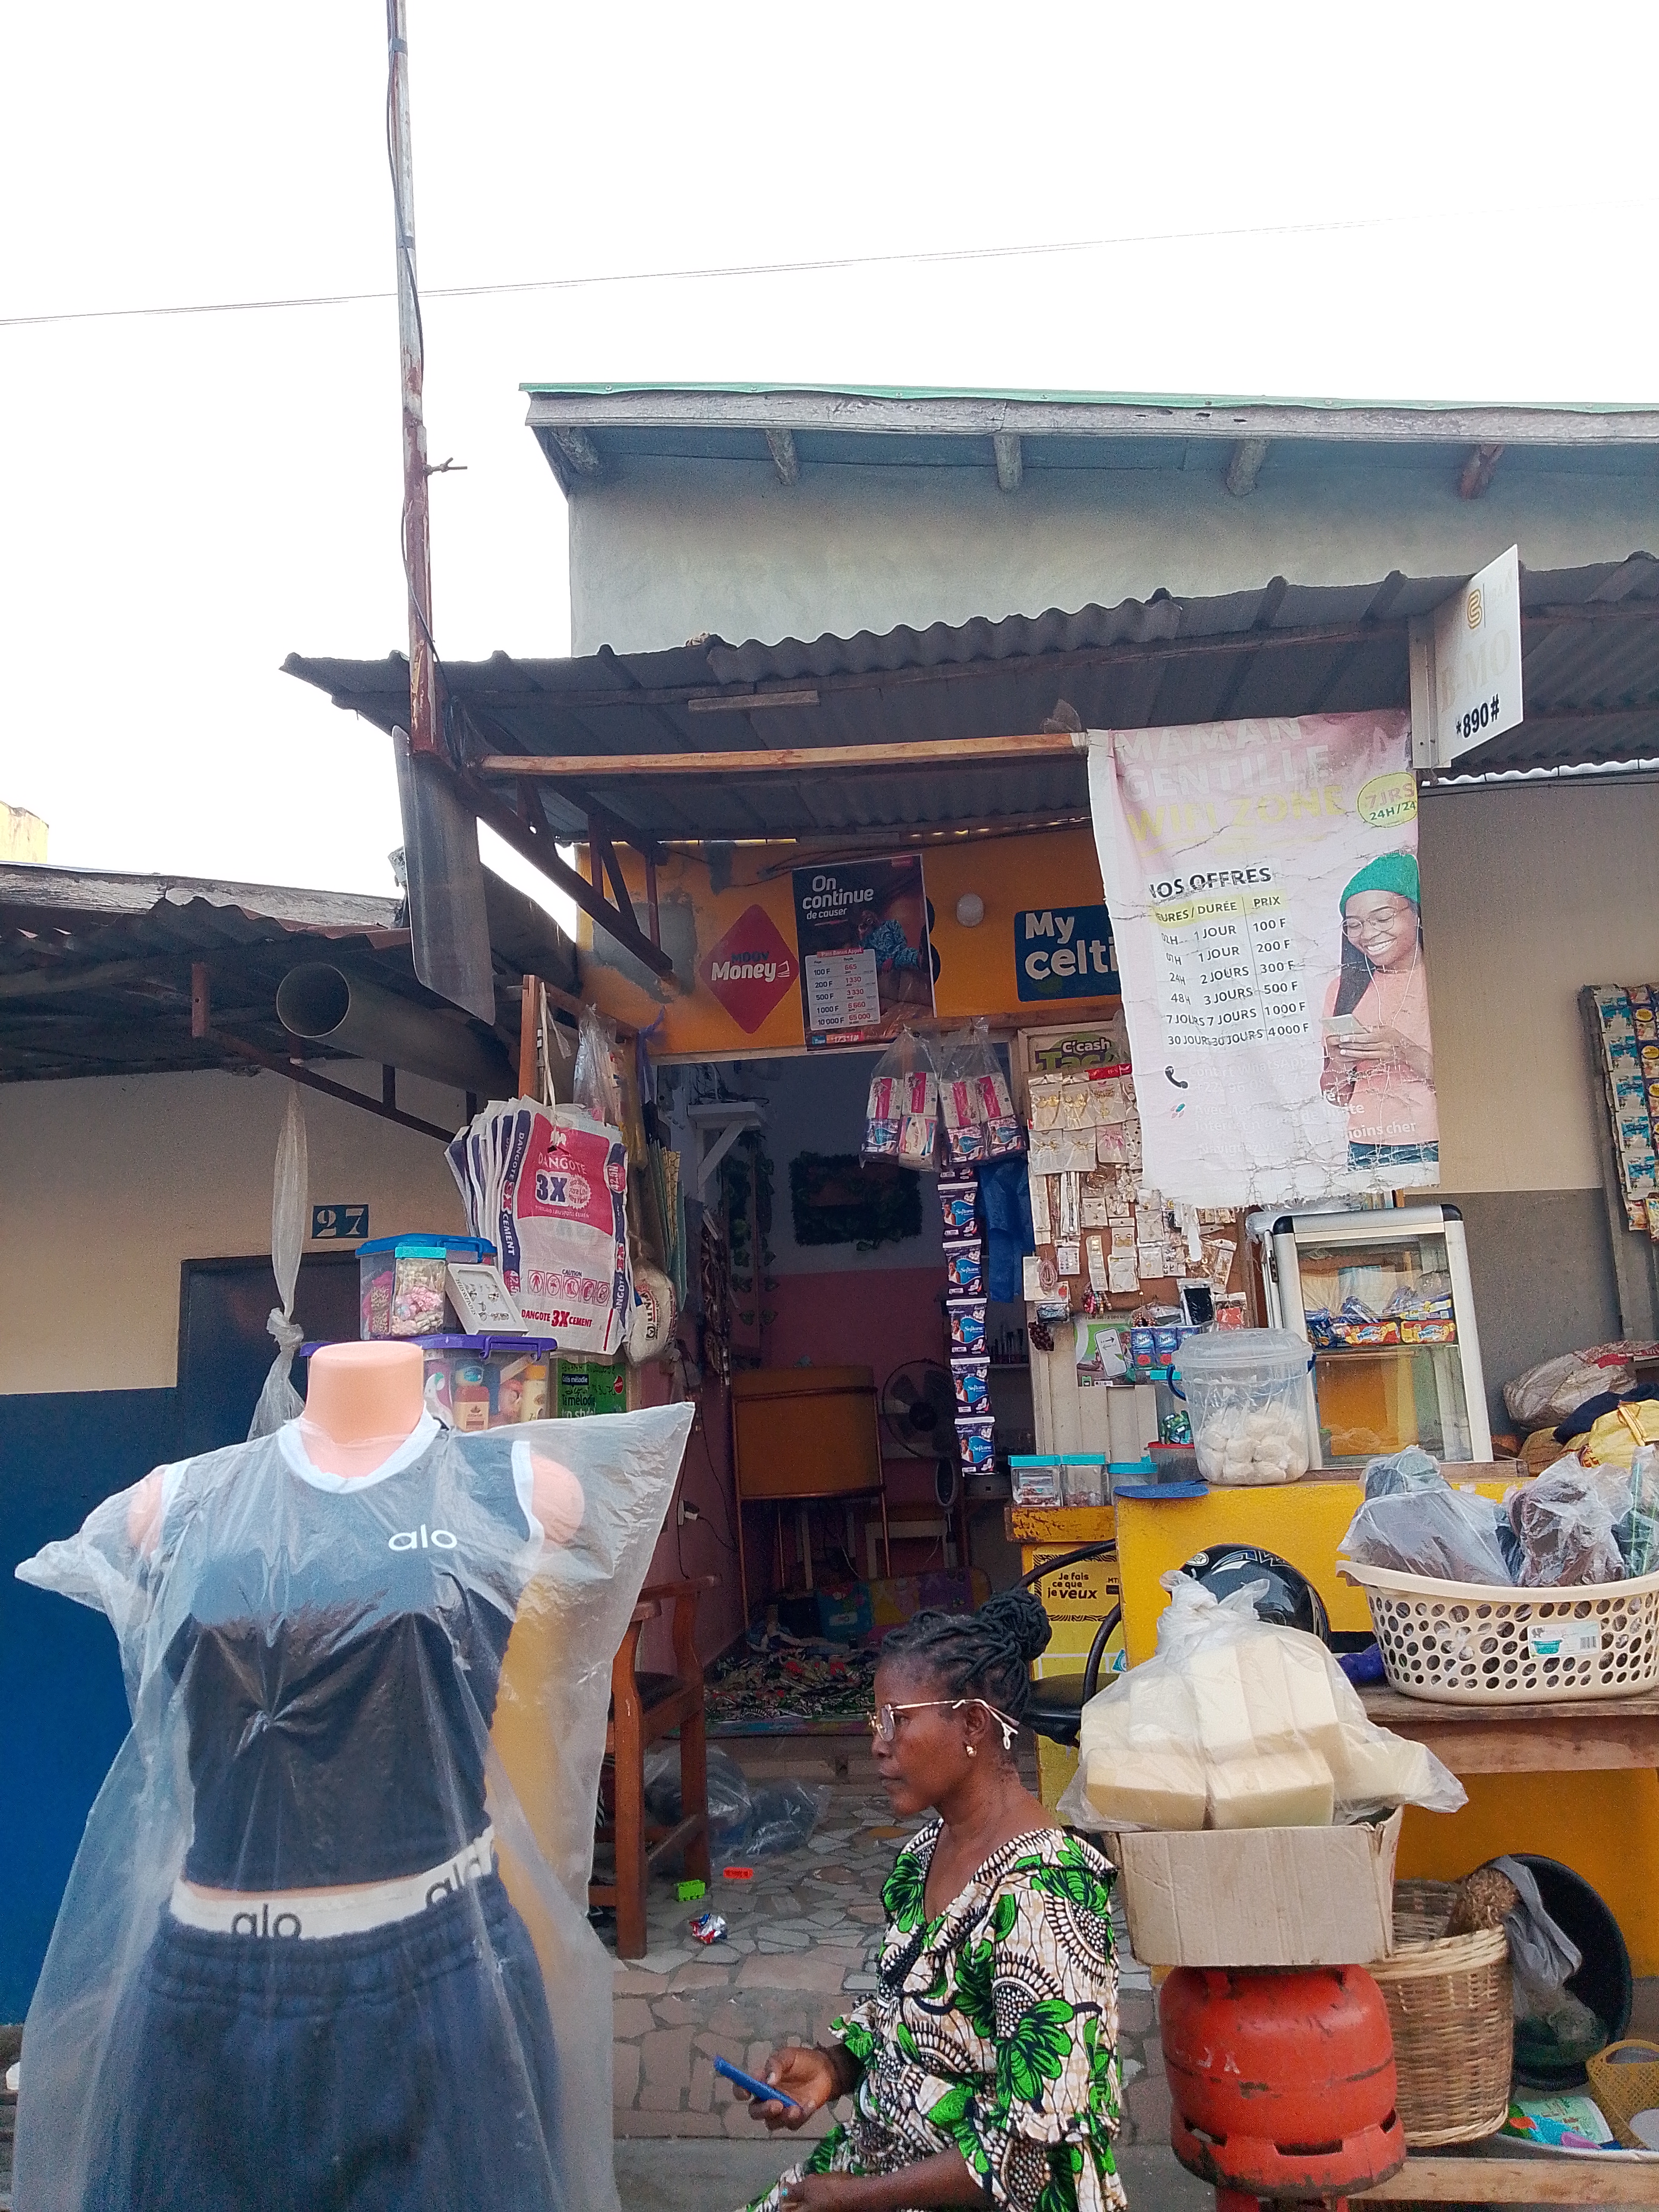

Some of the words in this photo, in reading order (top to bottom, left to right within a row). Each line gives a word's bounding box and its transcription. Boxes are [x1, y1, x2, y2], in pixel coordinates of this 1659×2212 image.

[1115, 718, 1302, 765] MAMAN
[1127, 802, 1218, 841] WIFI
[1229, 784, 1345, 827] ZONE
[812, 875, 836, 892] On
[1189, 867, 1272, 891] OFFRES
[802, 887, 874, 910] continue
[1197, 900, 1237, 915] DURÉE
[1253, 896, 1281, 907] PRIX
[806, 910, 817, 920] de
[818, 908, 848, 918] causer
[1025, 911, 1075, 944] My
[1203, 925, 1237, 940] JOUR
[1253, 919, 1276, 933] 100
[1279, 918, 1287, 928] F
[1207, 946, 1241, 961] JOUR
[1256, 941, 1281, 953] 200
[1284, 940, 1291, 949] F
[711, 960, 777, 983] Money
[1169, 972, 1186, 986] 24H
[1200, 975, 1208, 984] 2
[1210, 966, 1250, 983] JOURS
[1260, 961, 1284, 974] 300
[1171, 993, 1192, 1006] 48H
[1204, 995, 1211, 1005] 3
[1214, 987, 1254, 1004] JOURS
[1264, 983, 1288, 995] 500
[1291, 981, 1298, 991] F
[1217, 1008, 1257, 1025] JOURS
[1299, 1002, 1306, 1012] F
[1168, 1036, 1182, 1045] 30
[1227, 1029, 1263, 1045] JOURS
[1303, 1023, 1309, 1033] F
[1386, 1120, 1417, 1134] cher
[508, 1131, 525, 1182] DANGOTE
[538, 1152, 587, 1175] DANGOTE
[537, 1174, 568, 1202] 3X
[502, 1213, 515, 1256] CEMENT
[562, 1269, 582, 1277] CAUTION
[521, 1309, 551, 1321] DANGOTE
[551, 1309, 571, 1328] 3X
[569, 1316, 593, 1328] CEMENT
[388, 1523, 457, 1552] alo
[1071, 1572, 1089, 1580] fais
[1048, 1587, 1057, 1598] je
[1059, 1589, 1098, 1599] veux
[231, 1903, 302, 1937] alo
